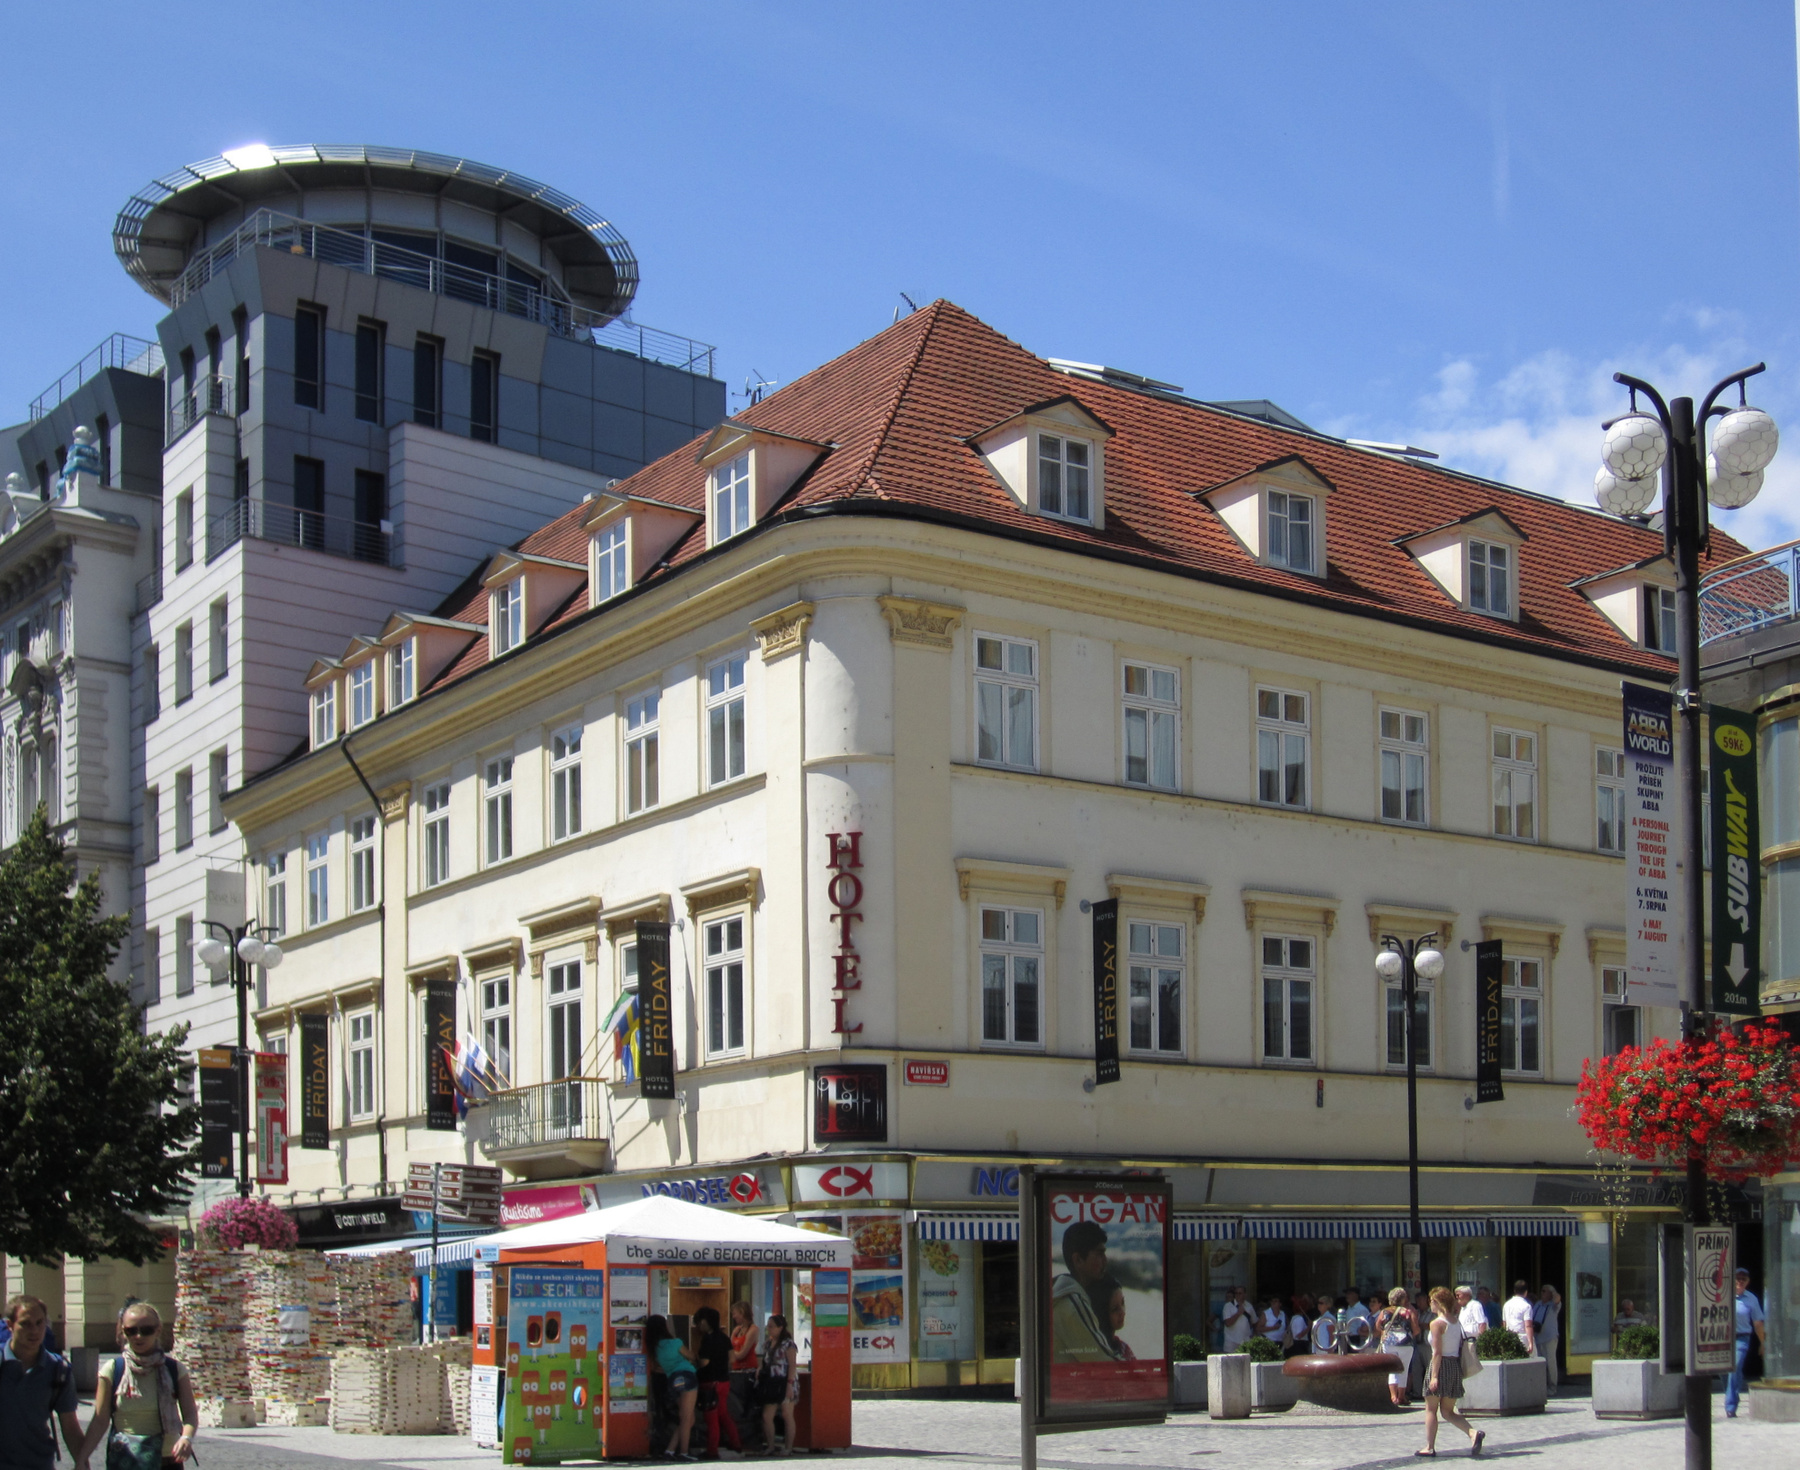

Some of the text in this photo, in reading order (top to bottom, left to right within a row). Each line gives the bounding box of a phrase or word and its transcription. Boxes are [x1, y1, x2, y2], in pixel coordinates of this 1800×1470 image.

[1628, 733, 1670, 755] WORLD
[1723, 736, 1745, 752] 59Kč
[1636, 762, 1664, 776] PROŽIJTE
[1637, 787, 1664, 800] SKUPINY
[1642, 800, 1659, 812] ABBA
[1632, 817, 1670, 832] A PERSONAL
[1637, 830, 1666, 843] JOURNEY
[1636, 842, 1667, 855] THROUGH
[1723, 768, 1750, 934] SUBWAY
[1639, 855, 1665, 867] THE LIFE
[1638, 867, 1667, 879] OF ABBA
[1636, 887, 1668, 900] 6. KVĚTNA
[1638, 900, 1667, 912] 7. SRPNA
[1096, 912, 1115, 921] HOTEL
[1643, 919, 1662, 930] 6 MAY
[640, 933, 666, 942] HOTEL
[826, 832, 863, 1034] HOTEL
[1638, 930, 1667, 942] 7 AUGUST
[430, 989, 453, 998] HOTEL
[1103, 940, 1116, 1039] FRIDAY
[1724, 992, 1748, 1006] 201m
[650, 960, 668, 1057] FRIDAY
[304, 1022, 326, 1030] HOTEL
[1487, 976, 1498, 1063] FRIDAY
[1100, 1058, 1117, 1067] HOTEL
[312, 1043, 326, 1119] FRIDAY
[1480, 1080, 1499, 1088] HOTEL
[430, 1110, 453, 1118] HOTEL
[641, 1176, 729, 1205] NORDSEE
[1698, 1234, 1730, 1250] PŘÍMO
[627, 1245, 836, 1262] the sale of BENEFICAL BRICK
[1700, 1304, 1729, 1324] PŘED
[923, 1322, 958, 1331] FRIDAY
